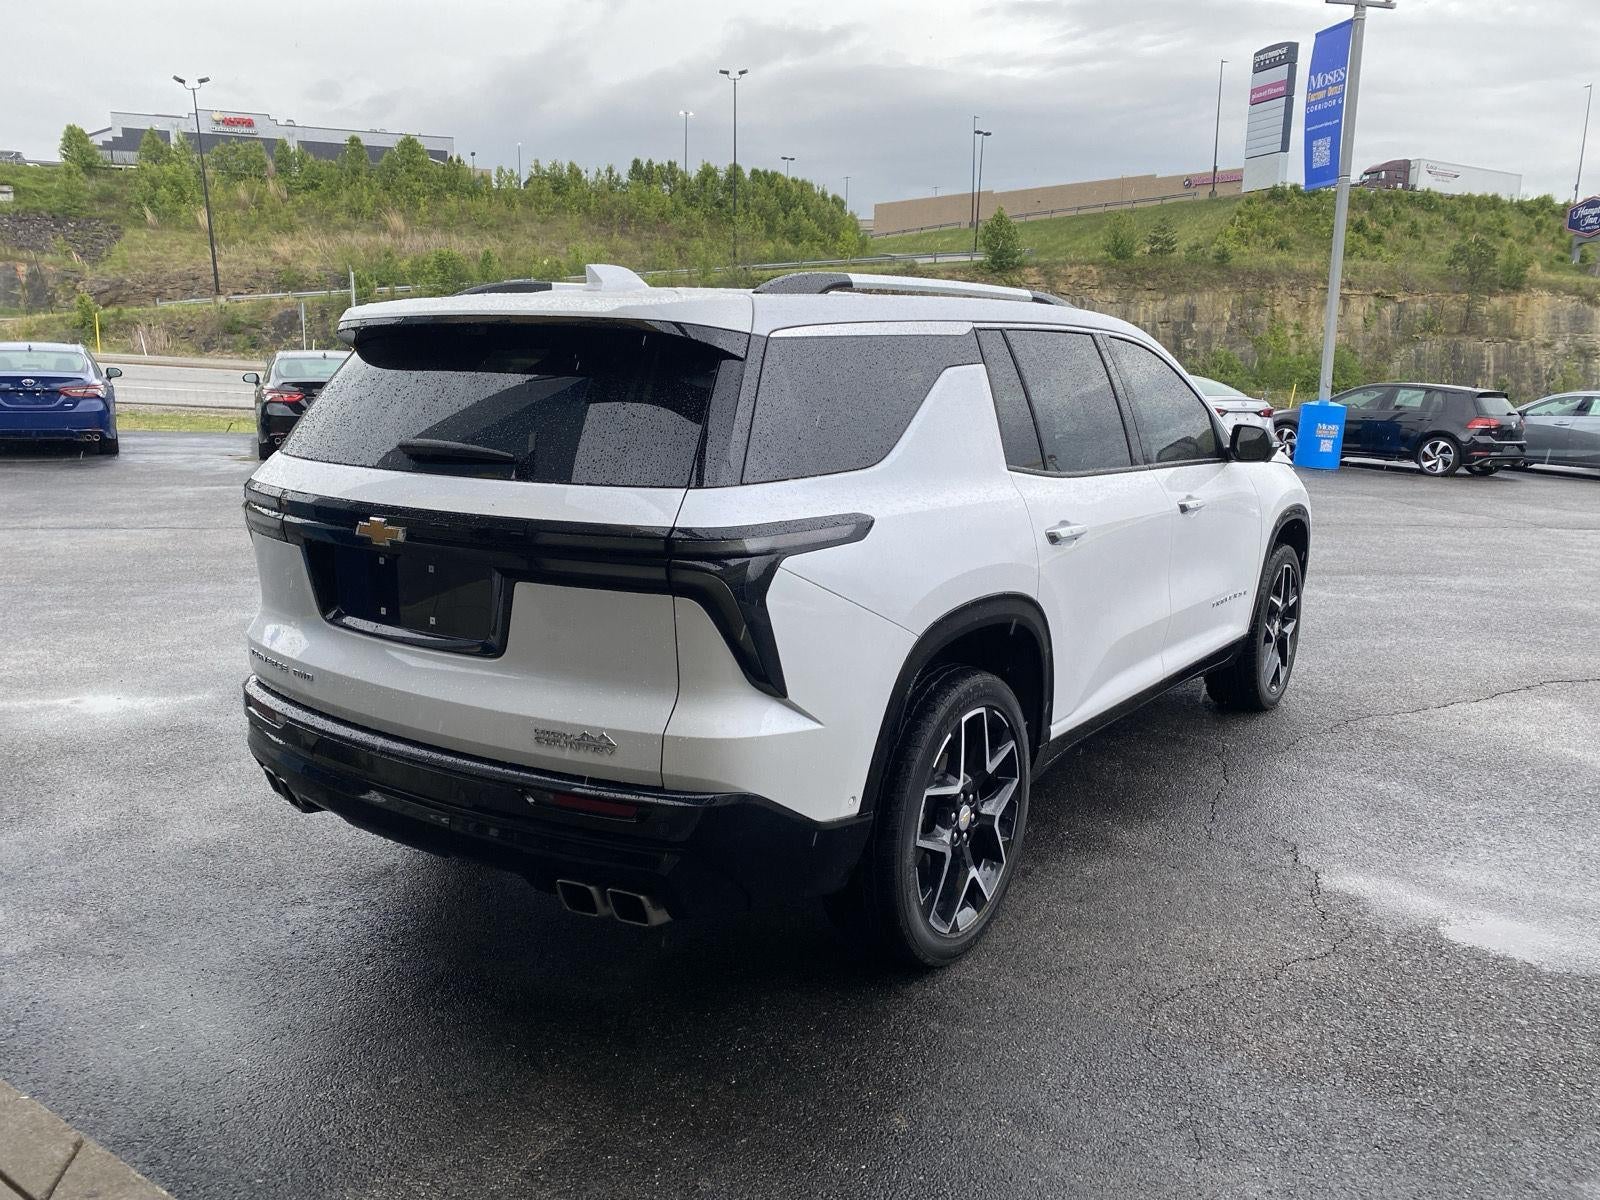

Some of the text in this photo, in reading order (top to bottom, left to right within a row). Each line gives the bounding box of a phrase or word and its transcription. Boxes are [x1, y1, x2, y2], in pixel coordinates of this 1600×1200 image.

[1309, 67, 1346, 91] MOSES
[1306, 99, 1337, 114] CORRIDOR
[1581, 215, 1600, 227] Inn
[534, 728, 575, 741] HIGH
[534, 736, 616, 756] COUNTRY
